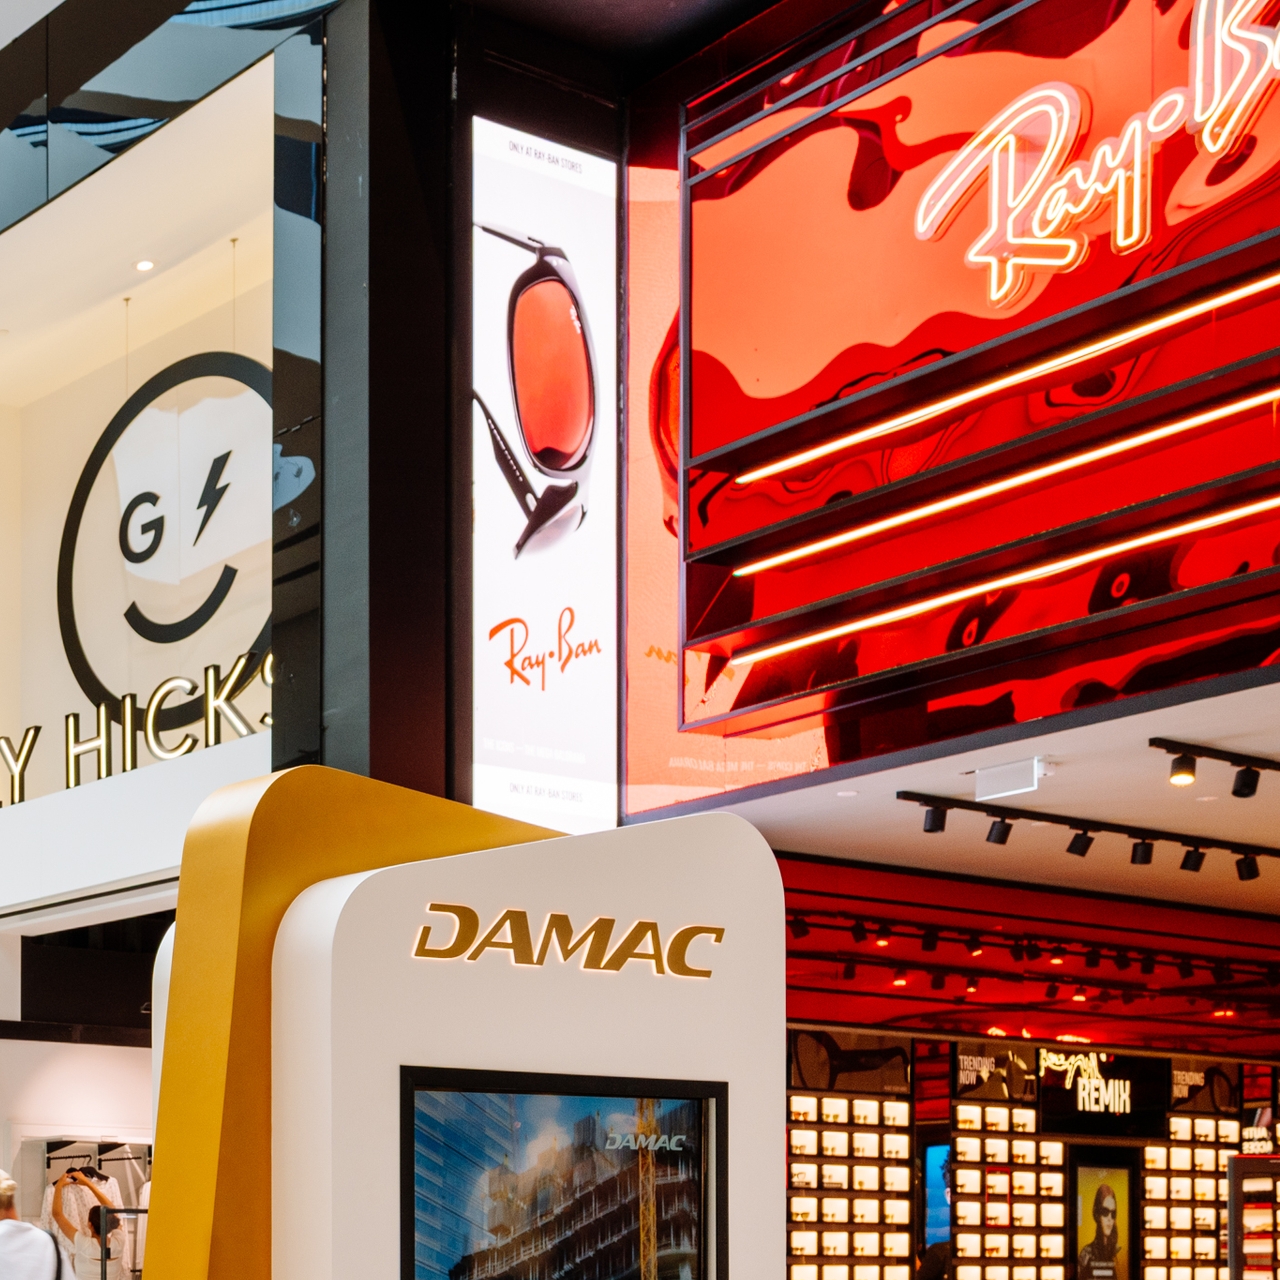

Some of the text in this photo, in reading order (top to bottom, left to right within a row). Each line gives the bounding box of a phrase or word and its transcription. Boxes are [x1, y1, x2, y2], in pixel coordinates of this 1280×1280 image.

[508, 140, 583, 174] ONLY AT RAY-BAN STORES
[413, 902, 725, 978] DAMAC
[958, 1055, 995, 1071] TRENDING
[959, 1070, 977, 1085] NOW
[1077, 1077, 1131, 1113] REMIX
[604, 1132, 687, 1152] DAMAC
